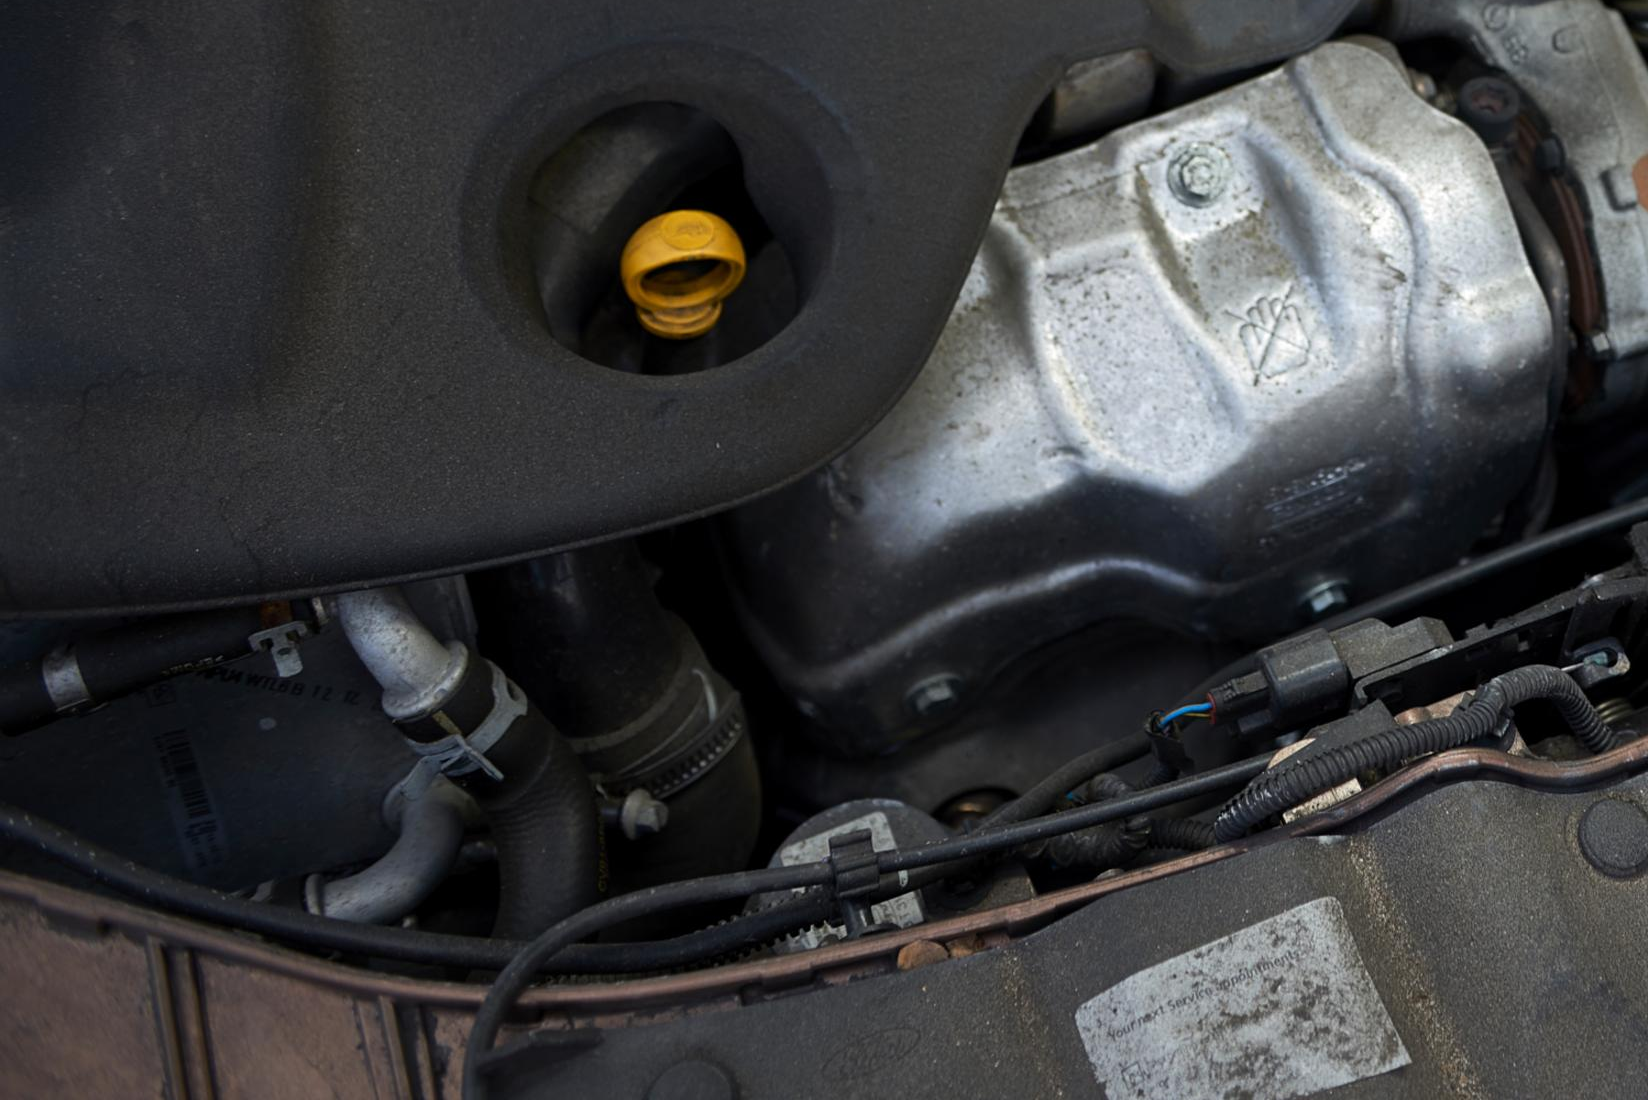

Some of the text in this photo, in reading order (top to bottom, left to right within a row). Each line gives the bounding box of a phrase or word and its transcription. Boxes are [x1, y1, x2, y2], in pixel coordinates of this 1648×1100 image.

[1108, 1019, 1136, 1041] Your
[1137, 1004, 1164, 1022] next
[1167, 986, 1212, 1012] Service
